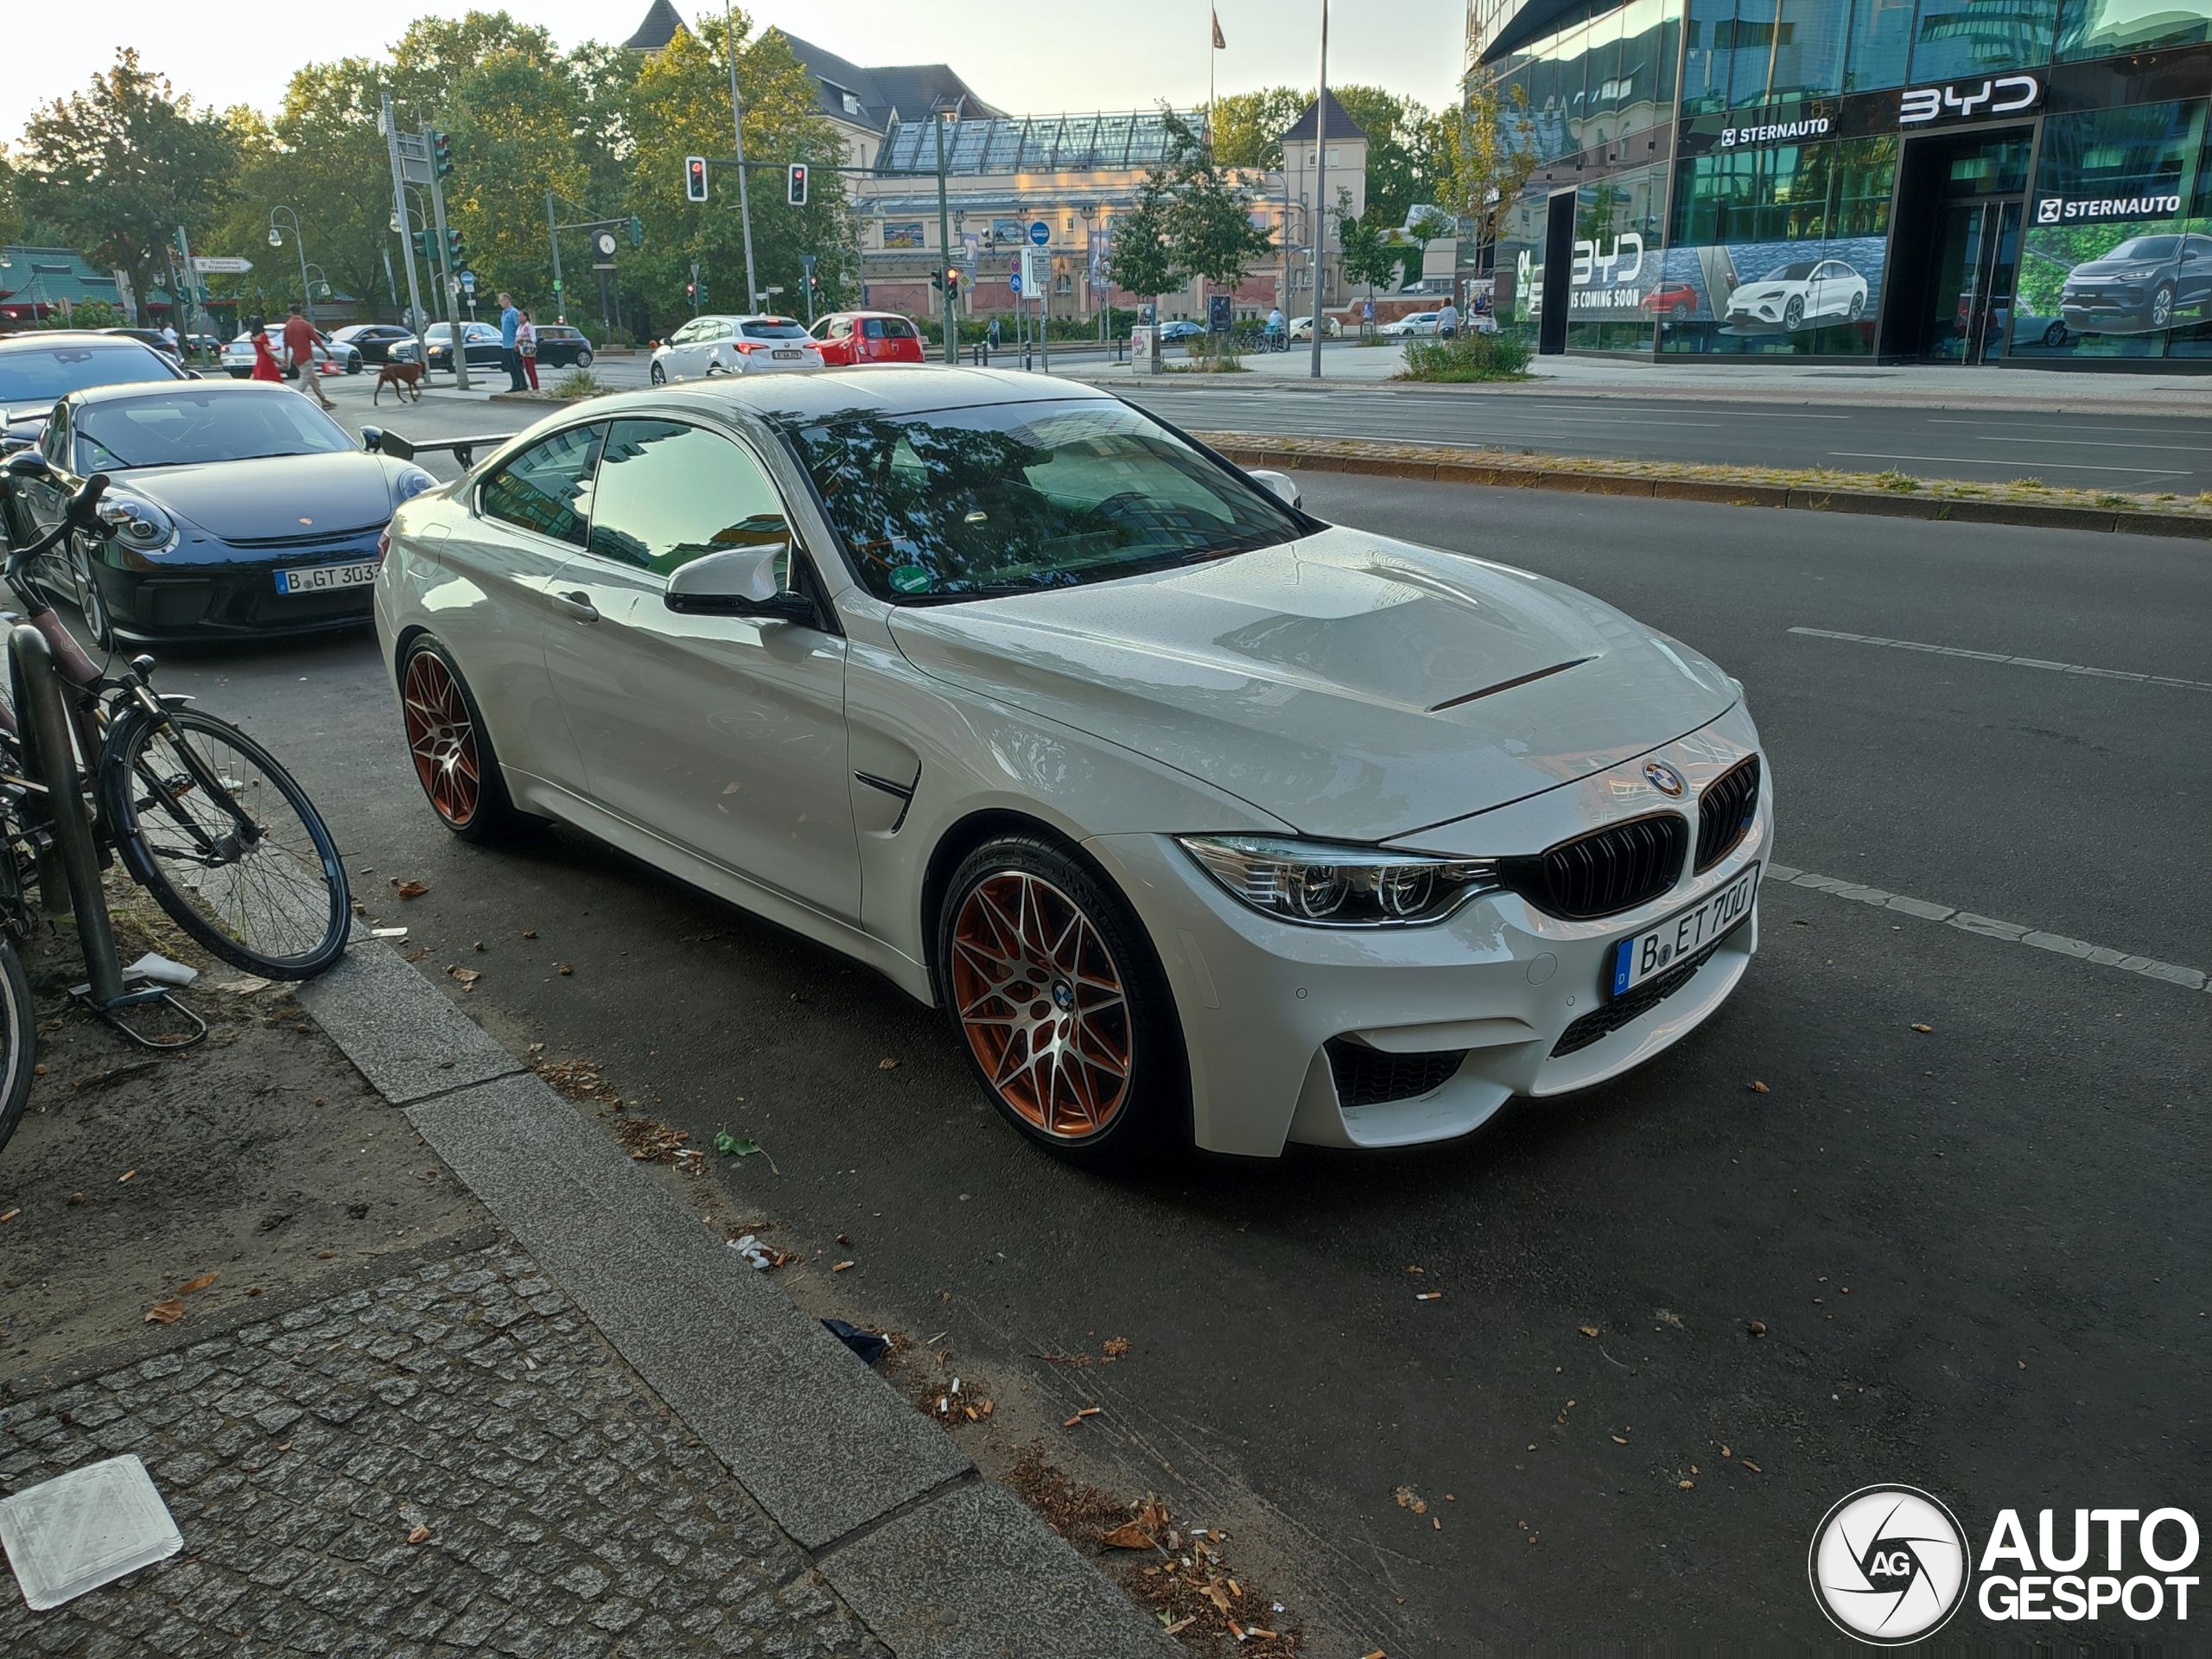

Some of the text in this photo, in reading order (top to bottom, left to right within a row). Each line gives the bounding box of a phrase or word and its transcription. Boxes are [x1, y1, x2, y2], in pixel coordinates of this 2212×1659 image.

[1898, 75, 2038, 124] BYD
[1739, 118, 1829, 143] STERNAUTO
[2064, 195, 2181, 218] STERNAUTO
[1517, 249, 1531, 283] Q4
[1572, 232, 1643, 285] BYD
[1570, 288, 1640, 308] IS COMING SOON
[288, 574, 301, 589] B
[313, 569, 336, 587] GT
[1618, 973, 1625, 985] D
[1640, 933, 1659, 976] B
[1675, 905, 1709, 958] ET
[1712, 877, 1749, 934] 700
